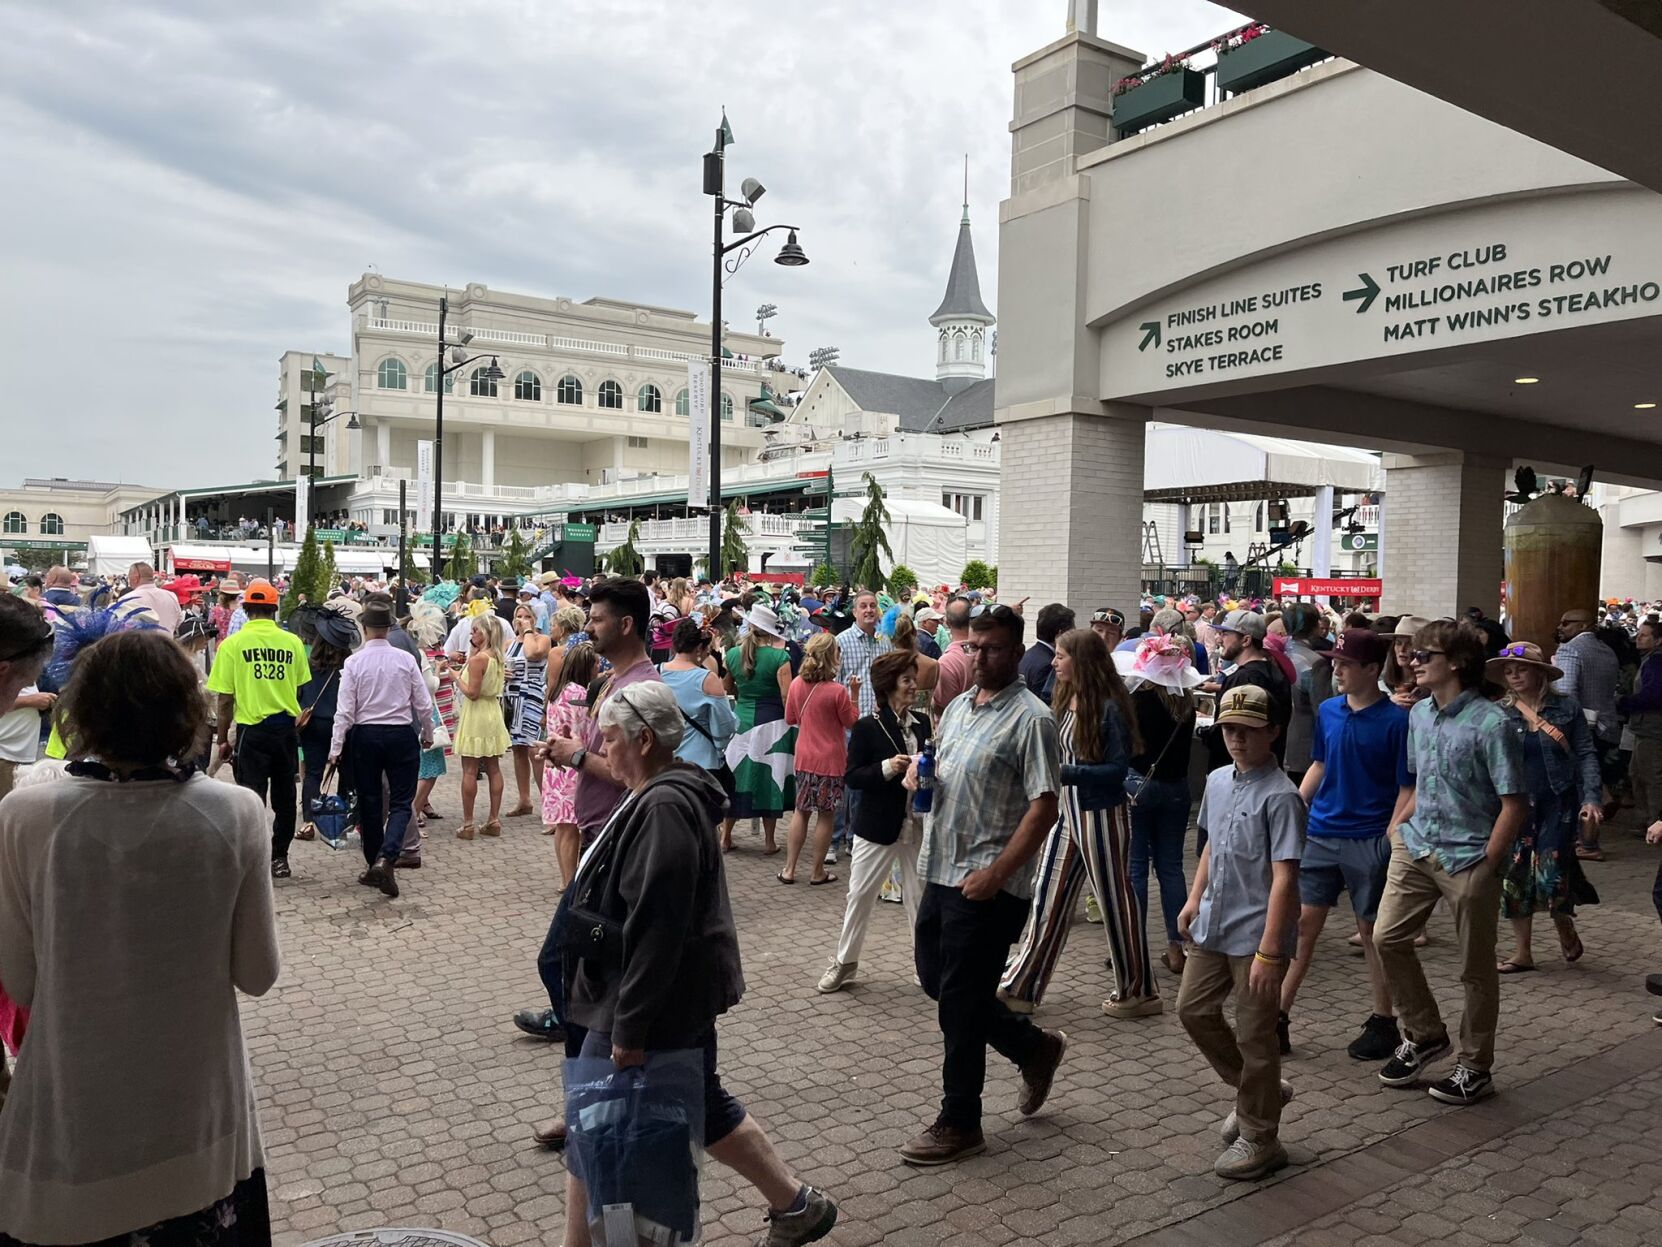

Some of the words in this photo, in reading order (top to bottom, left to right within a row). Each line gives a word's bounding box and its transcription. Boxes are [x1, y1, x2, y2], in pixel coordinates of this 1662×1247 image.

[1386, 256, 1442, 283] TURF
[1447, 243, 1507, 270] CLUB
[1384, 268, 1542, 313] MILLIONAIRES
[1549, 255, 1612, 284] ROW
[1167, 305, 1217, 328] FINISH
[1221, 296, 1258, 317] LINE
[1261, 282, 1322, 309] SUITES
[1383, 317, 1441, 342] MATT
[1446, 302, 1531, 332] WINN'S
[1537, 281, 1661, 318] STEAKHO
[1166, 330, 1223, 353] STAKES
[1227, 318, 1279, 342] ROOM
[1165, 358, 1204, 378] SKYE
[1207, 344, 1283, 371] TERRACE
[1311, 585, 1349, 593] KENTUCKY
[242, 647, 294, 665] VENDOR
[1231, 693, 1248, 711] W
